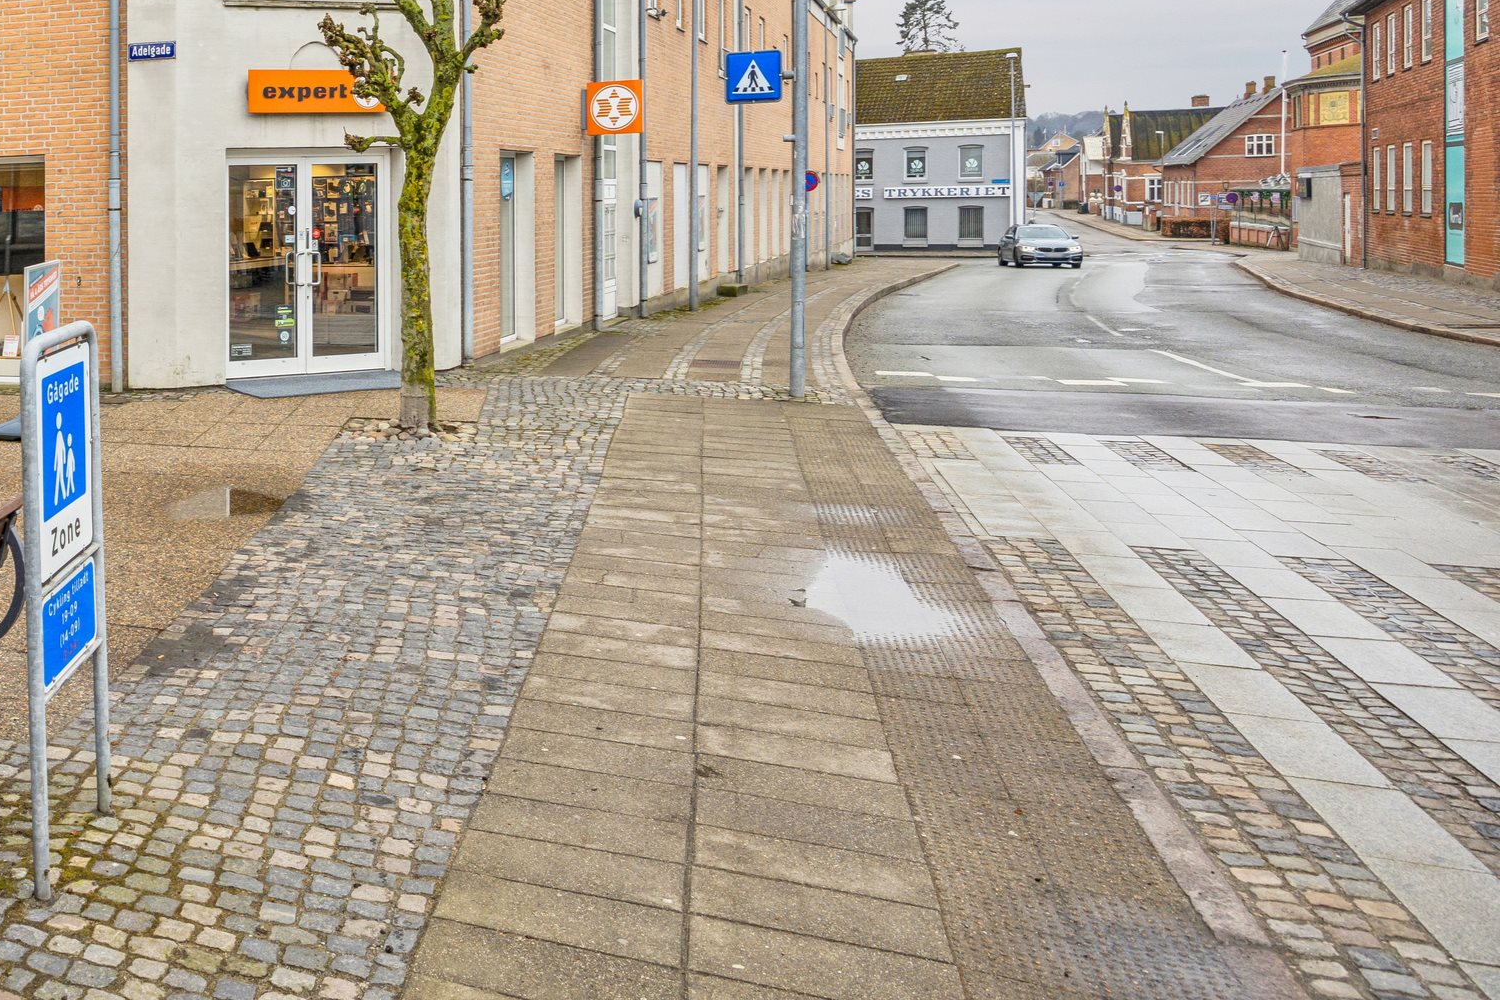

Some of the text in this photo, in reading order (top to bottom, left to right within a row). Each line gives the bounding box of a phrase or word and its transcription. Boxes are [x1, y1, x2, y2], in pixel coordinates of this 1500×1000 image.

[131, 44, 172, 58] Adelgade
[262, 83, 348, 102] expert
[884, 186, 1010, 198] TRYKKERIET
[48, 374, 79, 404] Gågade
[51, 518, 81, 558] Zone
[48, 572, 89, 617] Cykling tilladt
[62, 600, 78, 625] 19-09
[60, 617, 80, 648] (14-09)
